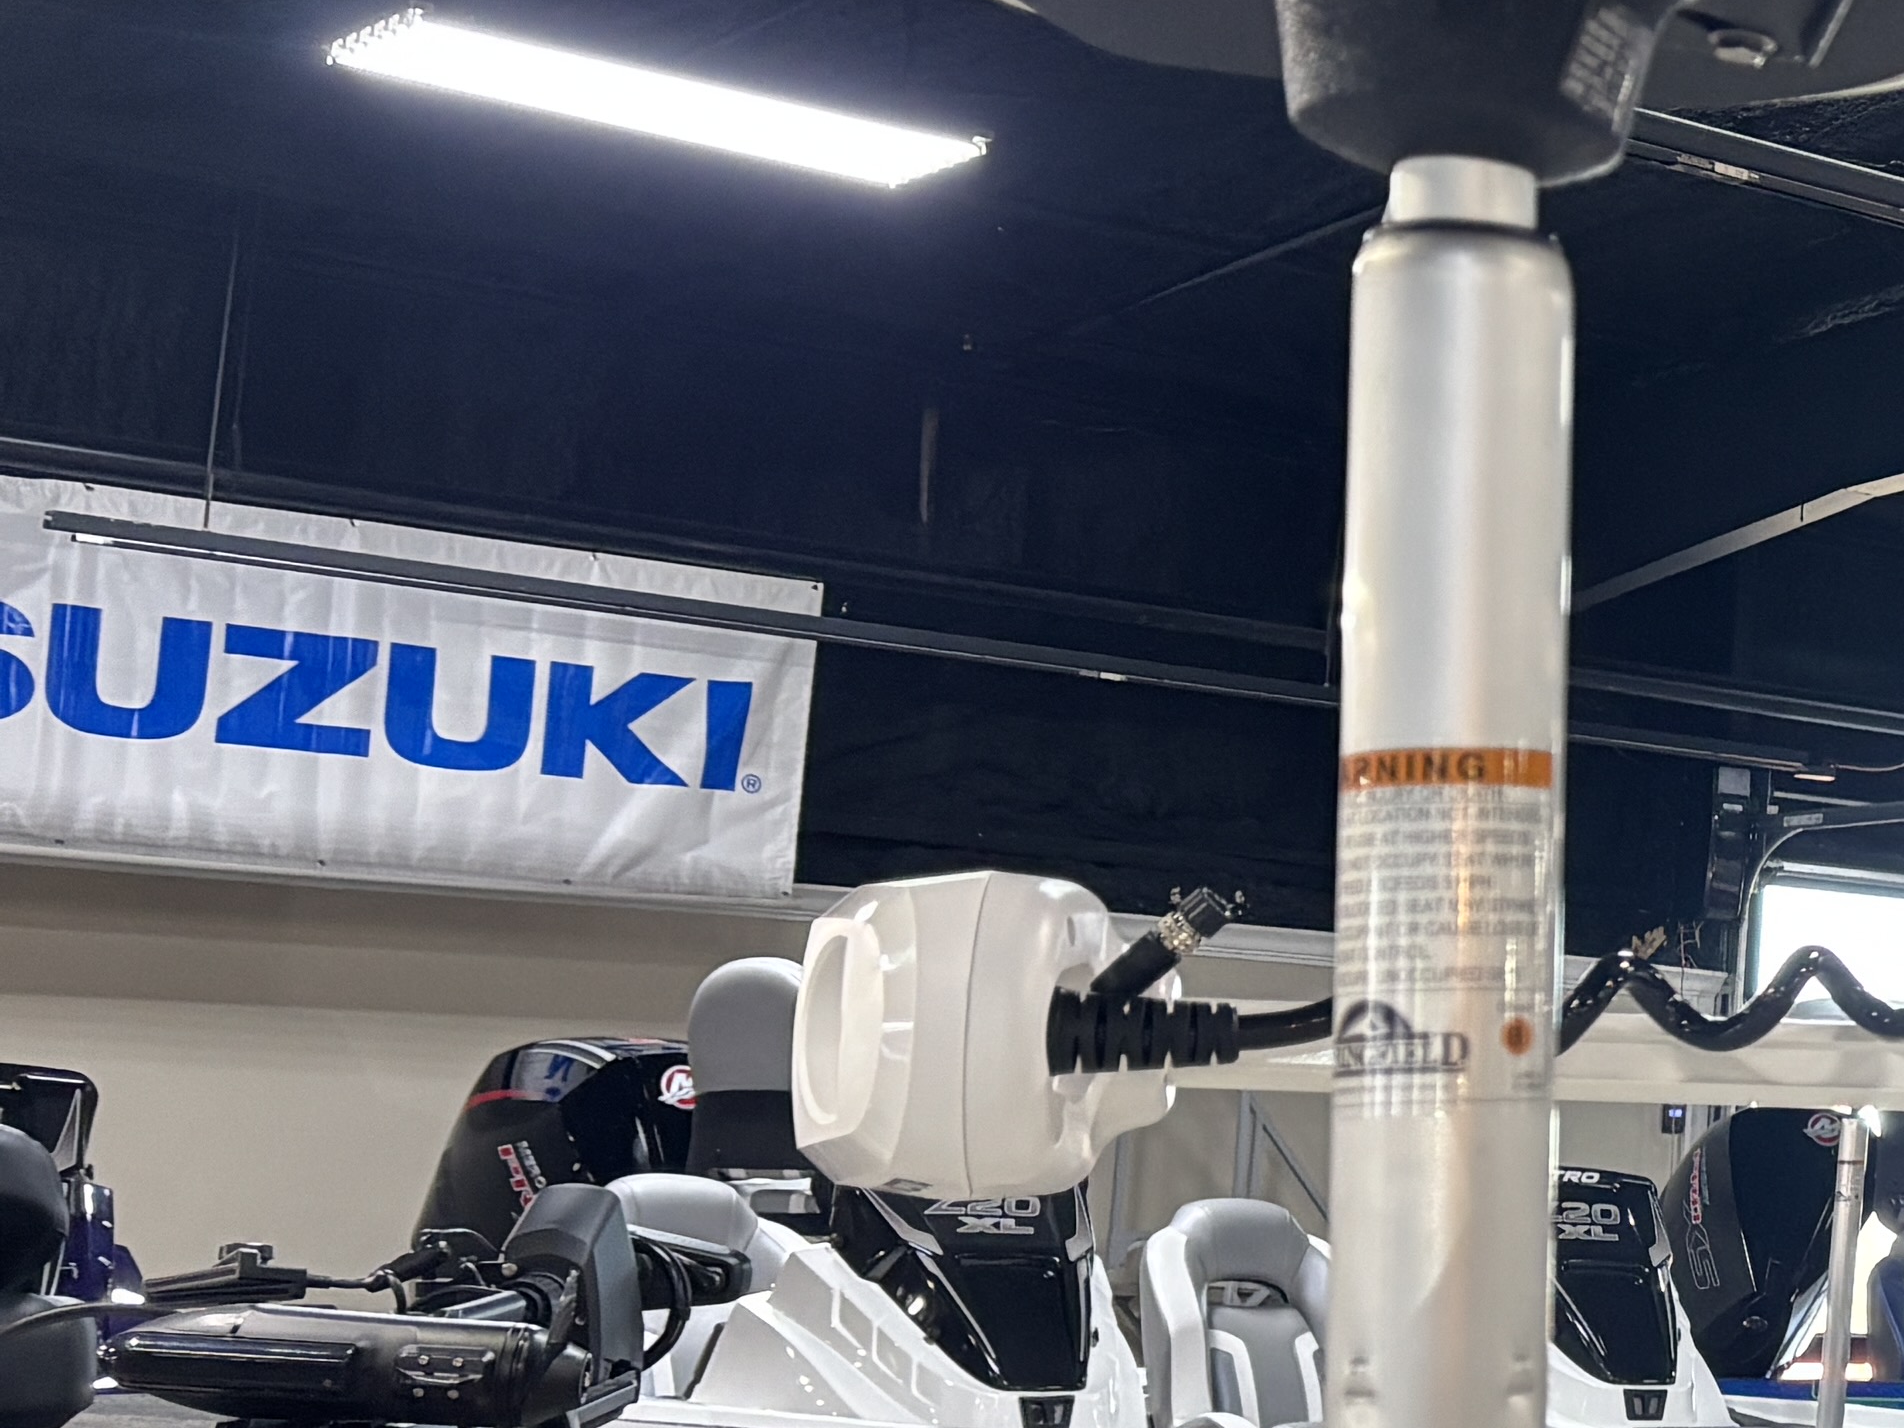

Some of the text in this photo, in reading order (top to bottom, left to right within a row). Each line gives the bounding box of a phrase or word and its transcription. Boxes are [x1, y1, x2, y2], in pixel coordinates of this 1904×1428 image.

[0, 602, 753, 792] UZUKI
[1341, 749, 1486, 785] RNING
[1553, 1169, 1601, 1185] TRO
[956, 1215, 1035, 1235] XL
[1557, 1224, 1620, 1242] XL
